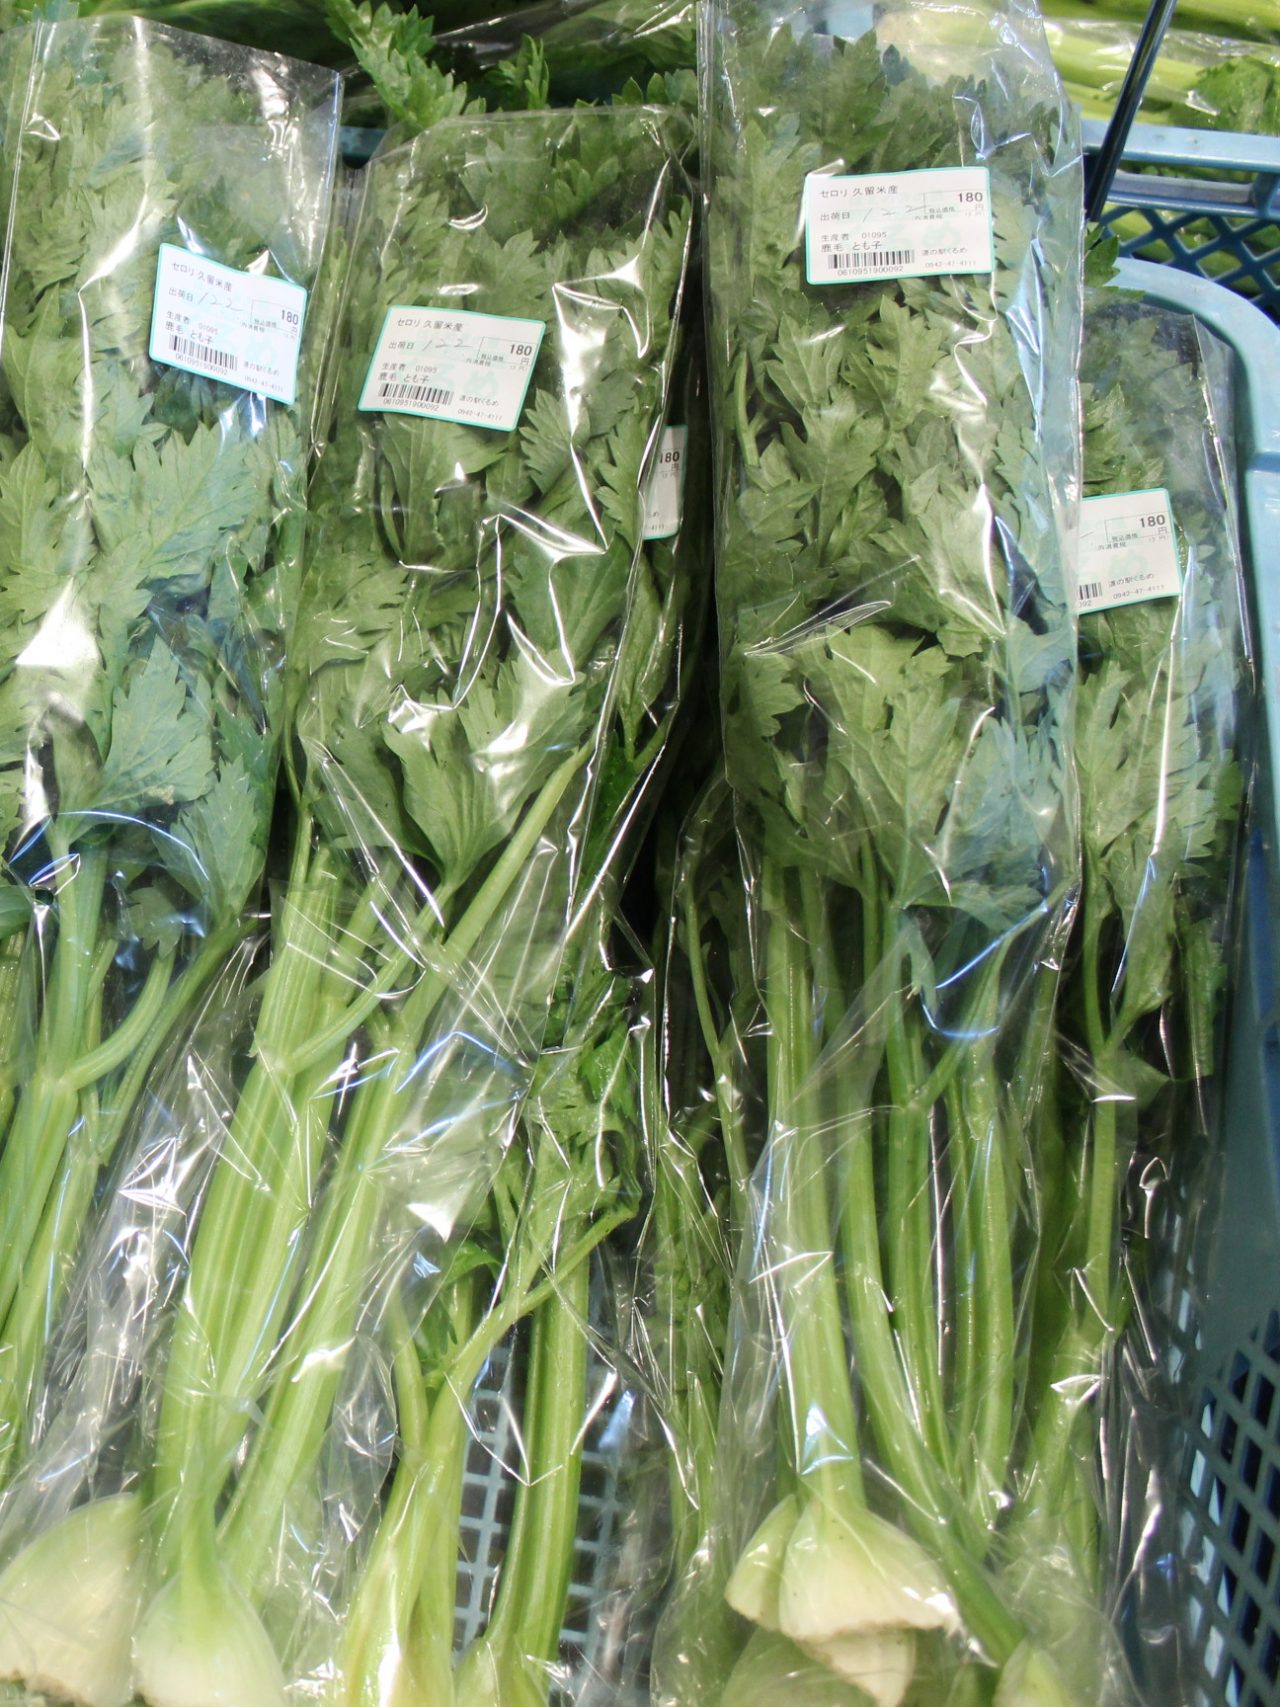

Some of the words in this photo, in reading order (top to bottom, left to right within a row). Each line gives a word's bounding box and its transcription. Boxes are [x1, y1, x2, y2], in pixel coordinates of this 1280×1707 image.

[819, 189, 848, 198] セロリ
[852, 185, 898, 197] 久留米産
[957, 191, 983, 203] 180
[820, 211, 850, 222] 出荷日
[821, 233, 849, 242] 生産者
[861, 231, 887, 239] 01095
[821, 243, 843, 252] 鹿毛
[852, 240, 882, 251] とも子
[171, 262, 195, 277] セロリ
[198, 271, 233, 293] 久留米産
[166, 310, 190, 325] 生産者
[280, 309, 299, 326] 180
[396, 318, 420, 328] セロリ
[423, 320, 464, 331] 久留米産
[190, 330, 214, 345] とも子
[388, 341, 415, 350] 出荷日
[509, 343, 533, 357] 180
[381, 362, 406, 372] 生産者
[378, 372, 397, 382] 鹿毛
[403, 373, 430, 384] とも子
[1139, 514, 1166, 528] 180
[1158, 526, 1168, 534] 円
